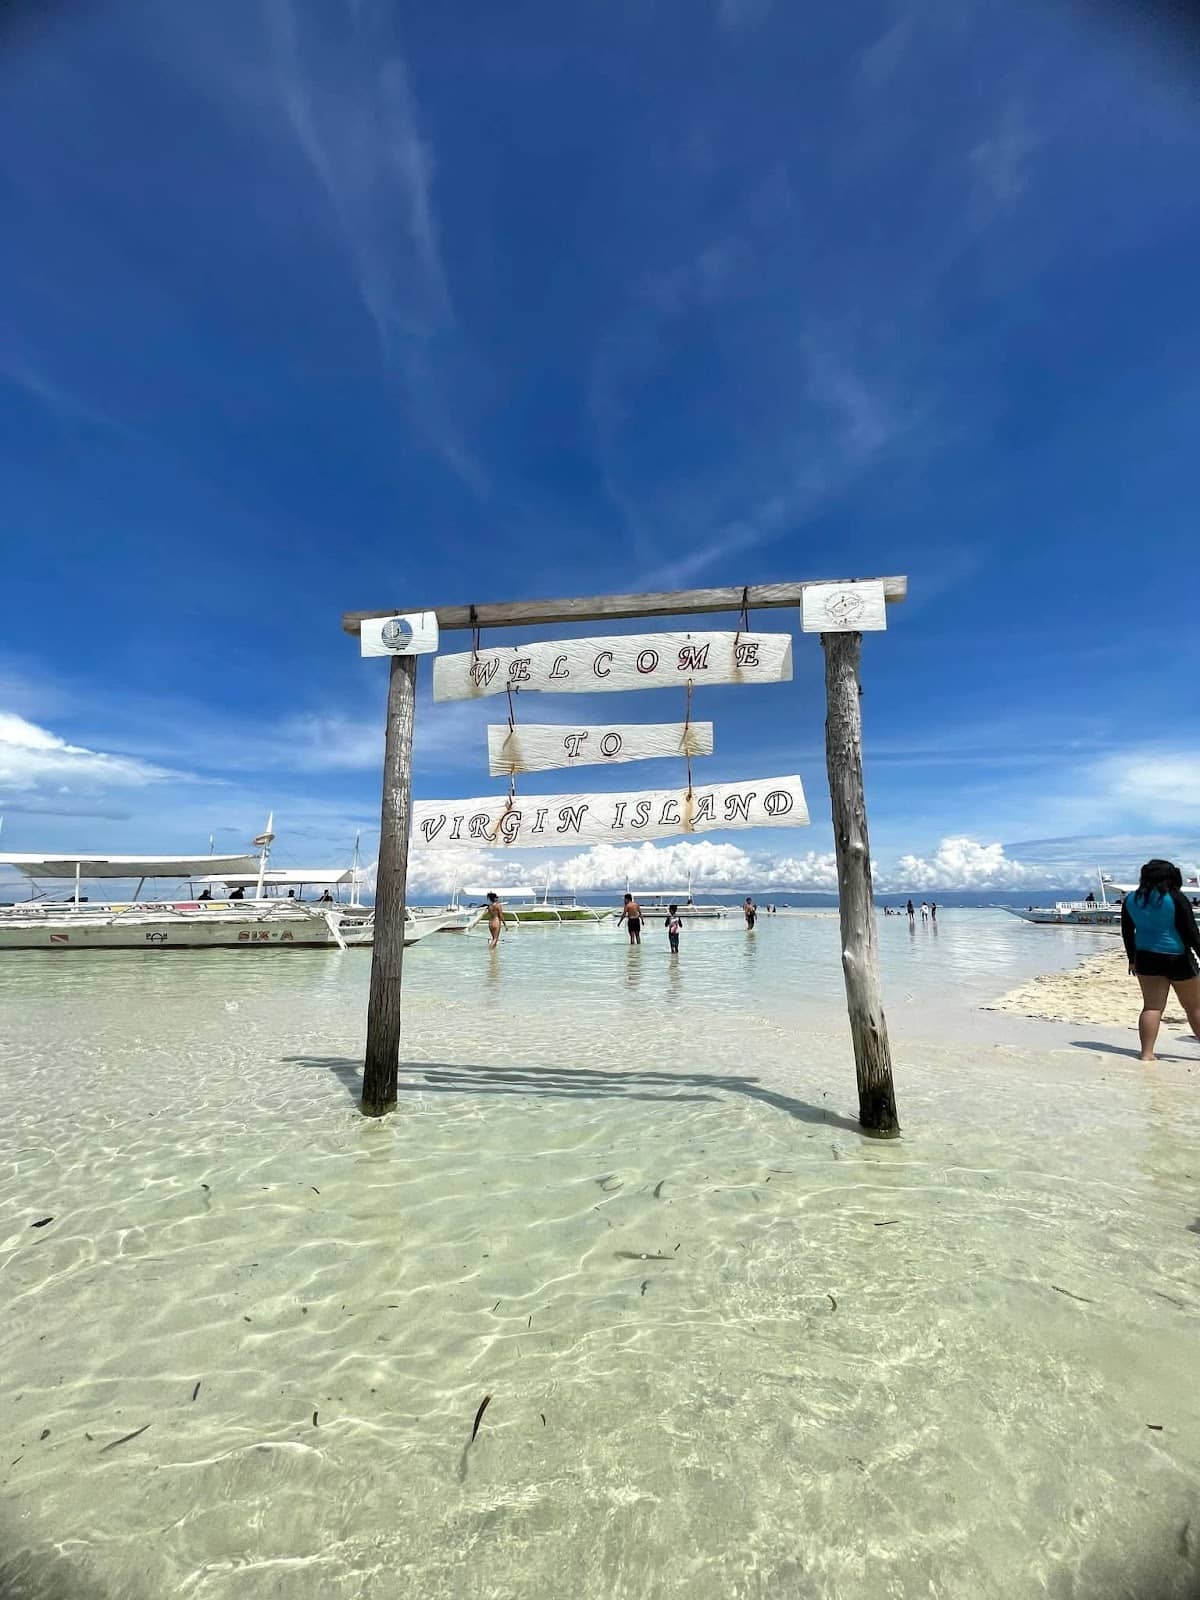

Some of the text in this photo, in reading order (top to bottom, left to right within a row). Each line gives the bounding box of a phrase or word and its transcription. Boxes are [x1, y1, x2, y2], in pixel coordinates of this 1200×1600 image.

[469, 643, 760, 688] WELCOME
[564, 731, 622, 758] TO
[420, 790, 794, 844] VIRGIN ISLAND
